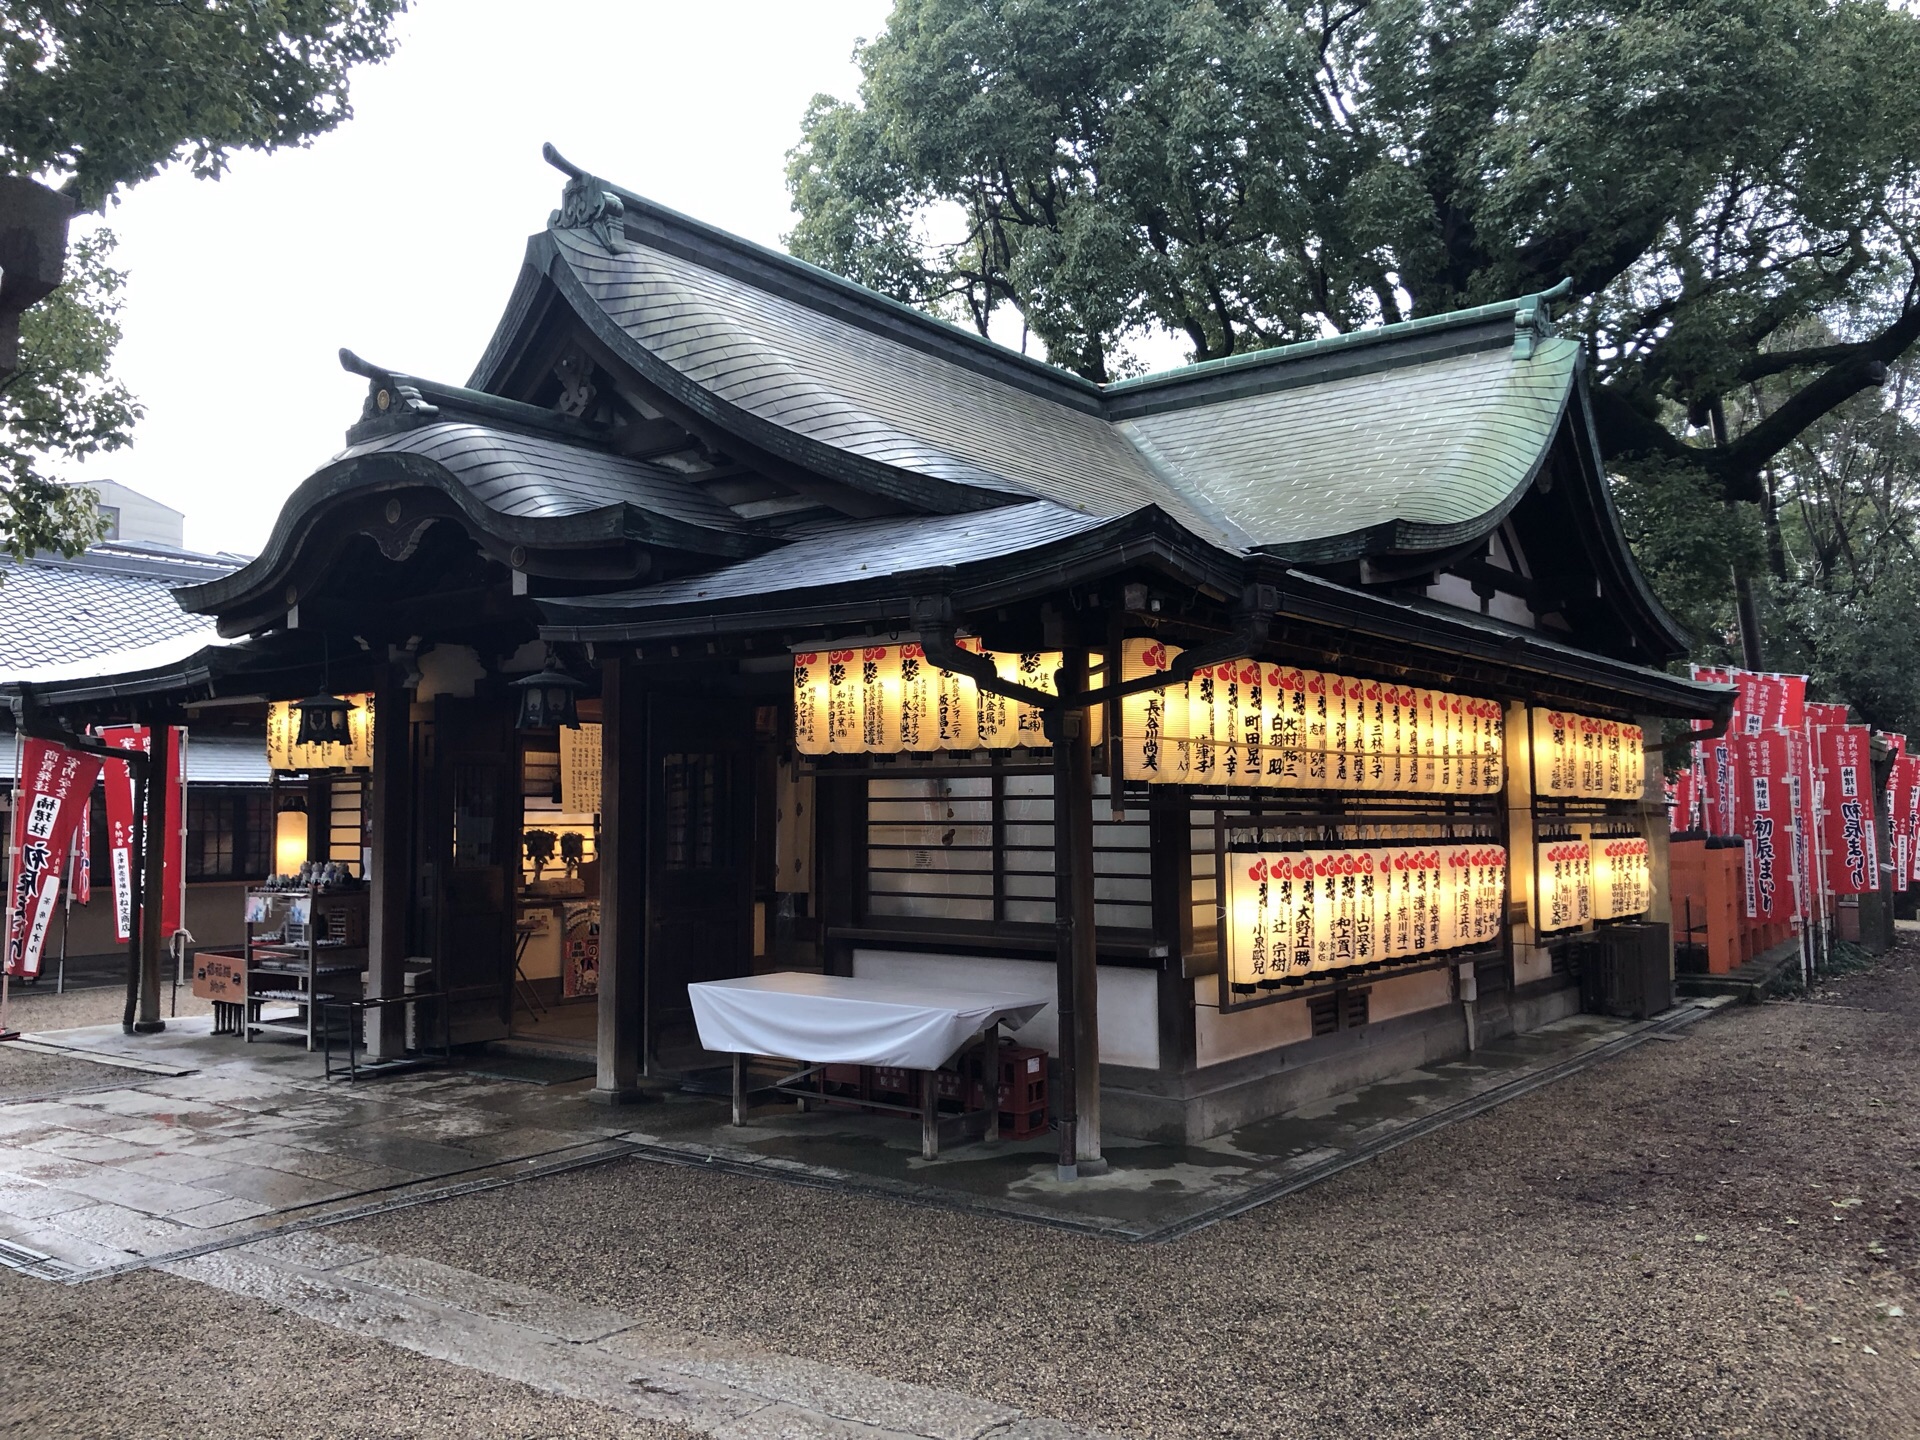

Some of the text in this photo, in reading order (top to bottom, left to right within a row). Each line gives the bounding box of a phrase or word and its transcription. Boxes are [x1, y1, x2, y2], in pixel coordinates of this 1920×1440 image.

[1142, 699, 1160, 771] 長谷川尚美
[1244, 714, 1260, 774] 町田晃一
[1370, 725, 1384, 779] 三林京子
[1747, 742, 1758, 776] 家内安全
[1756, 779, 1769, 809] 楠珺社
[1753, 814, 1775, 918] 初辰まいり
[1293, 904, 1311, 967] 大野正勝
